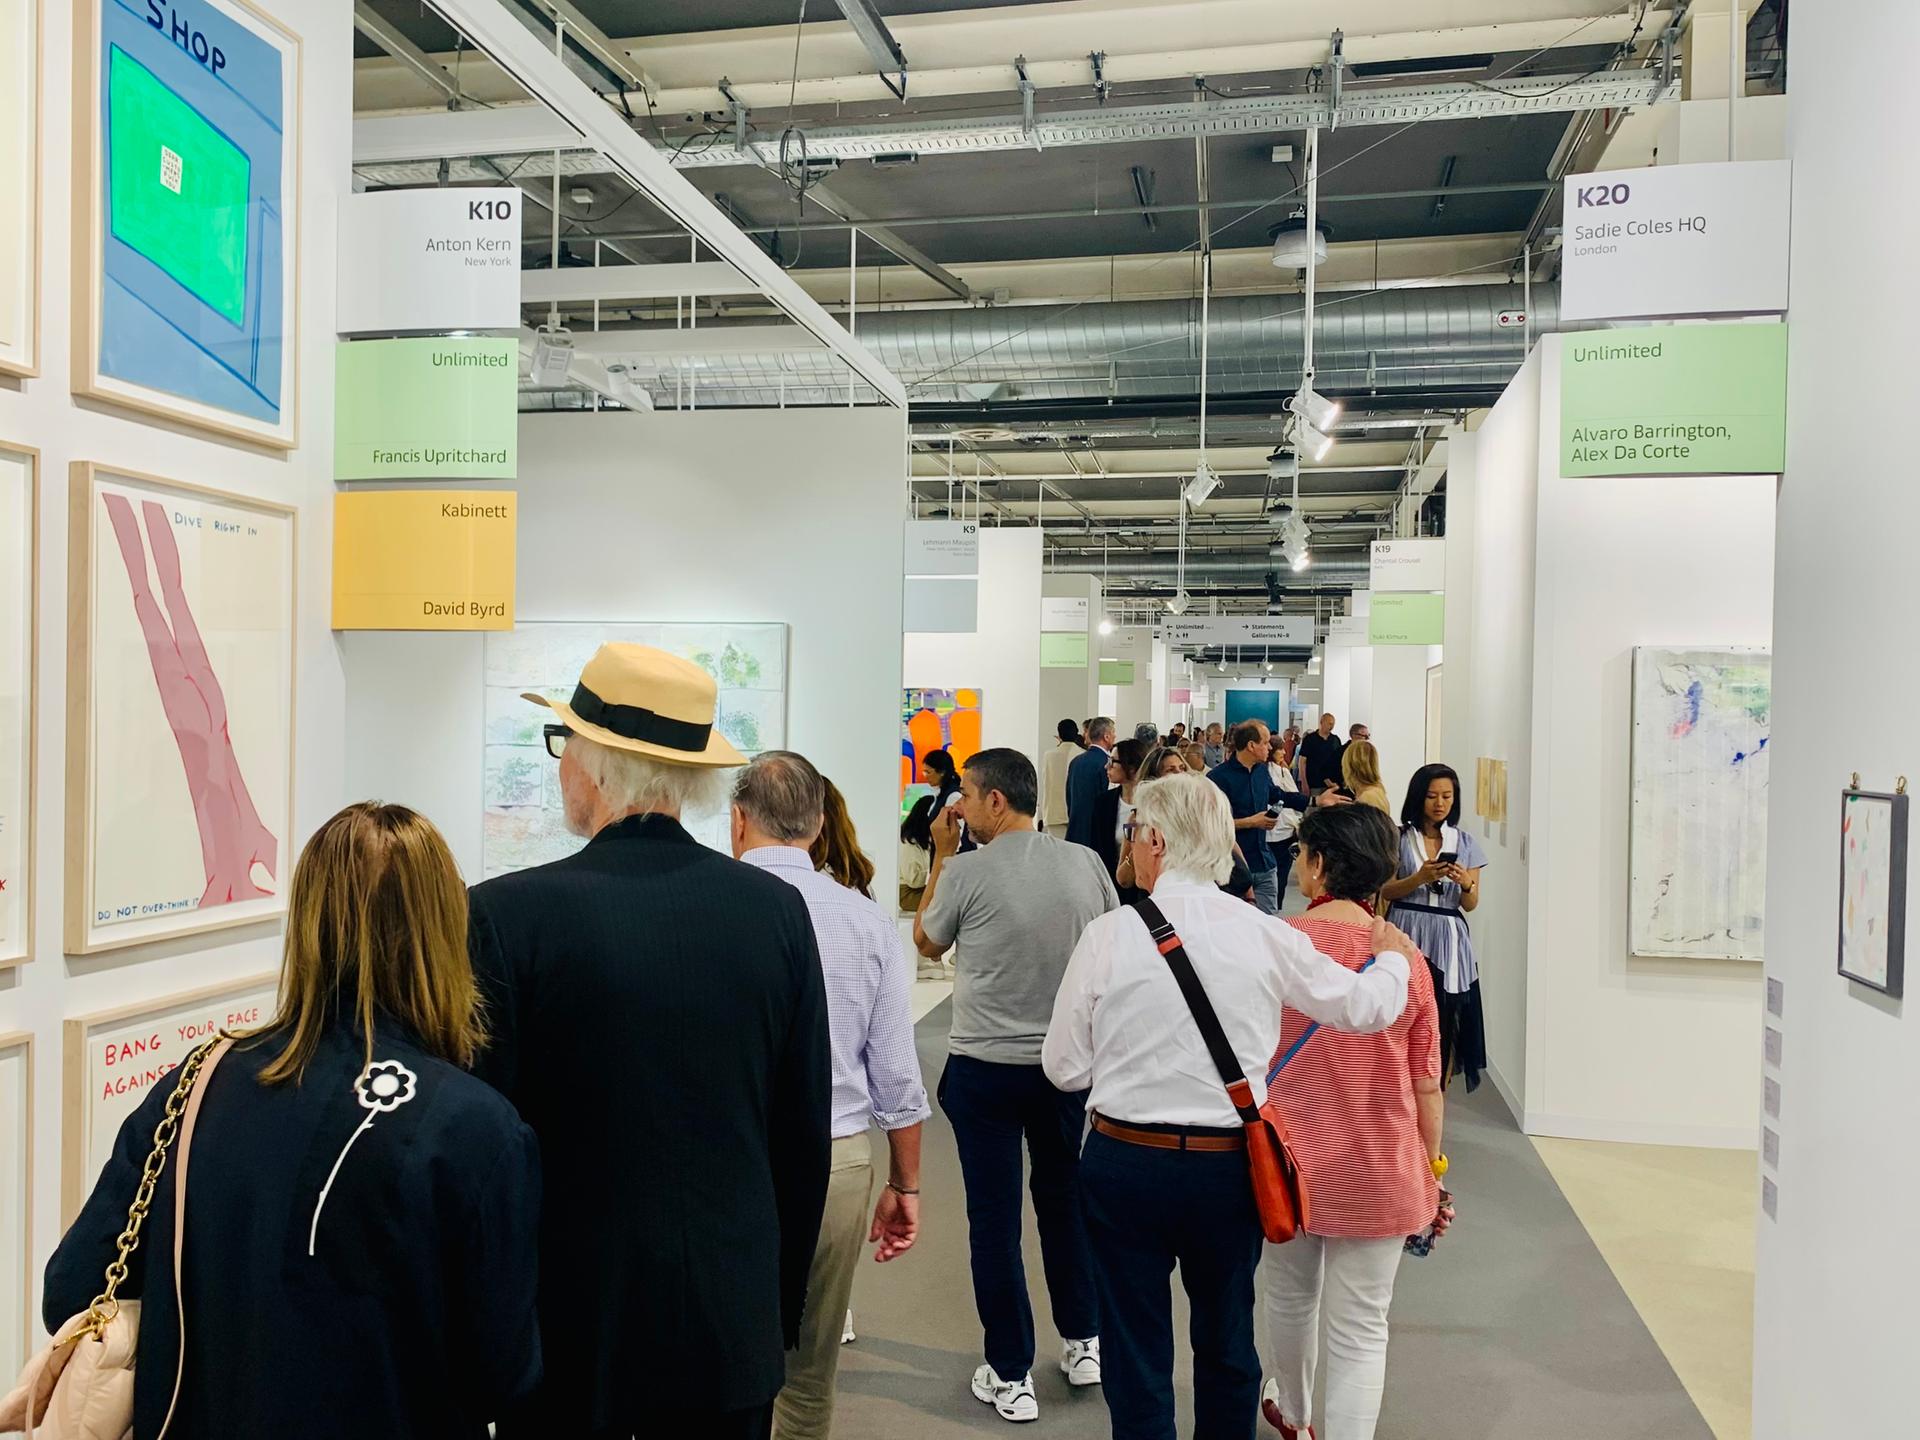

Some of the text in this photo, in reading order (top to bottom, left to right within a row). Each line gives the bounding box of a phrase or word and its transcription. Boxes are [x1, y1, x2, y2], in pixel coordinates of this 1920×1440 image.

[147, 0, 226, 74] SHOP
[1577, 183, 1630, 208] K20
[469, 201, 512, 220] K10
[1575, 216, 1707, 240] Sadie Coles HQ
[425, 237, 512, 252] Anton Kern
[1574, 243, 1617, 257] London
[464, 257, 512, 266] New York
[432, 352, 508, 367] Unlimited
[1574, 343, 1662, 362] Unlimited
[1571, 423, 1732, 443] Alvaro Barrington,
[373, 449, 507, 465] Francis Upritchard
[1571, 444, 1690, 462] Alex Da Corte
[441, 503, 508, 518] Kabinett
[174, 512, 257, 536] DIVE RIGHT IN
[963, 525, 976, 534] K9
[1375, 545, 1391, 553] K19
[423, 601, 505, 619] David Byrd
[98, 911, 110, 920] DO
[116, 905, 137, 918] NOT
[142, 900, 188, 913] OVER-THINK
[105, 1008, 258, 1066] BANG YOUR FACE
